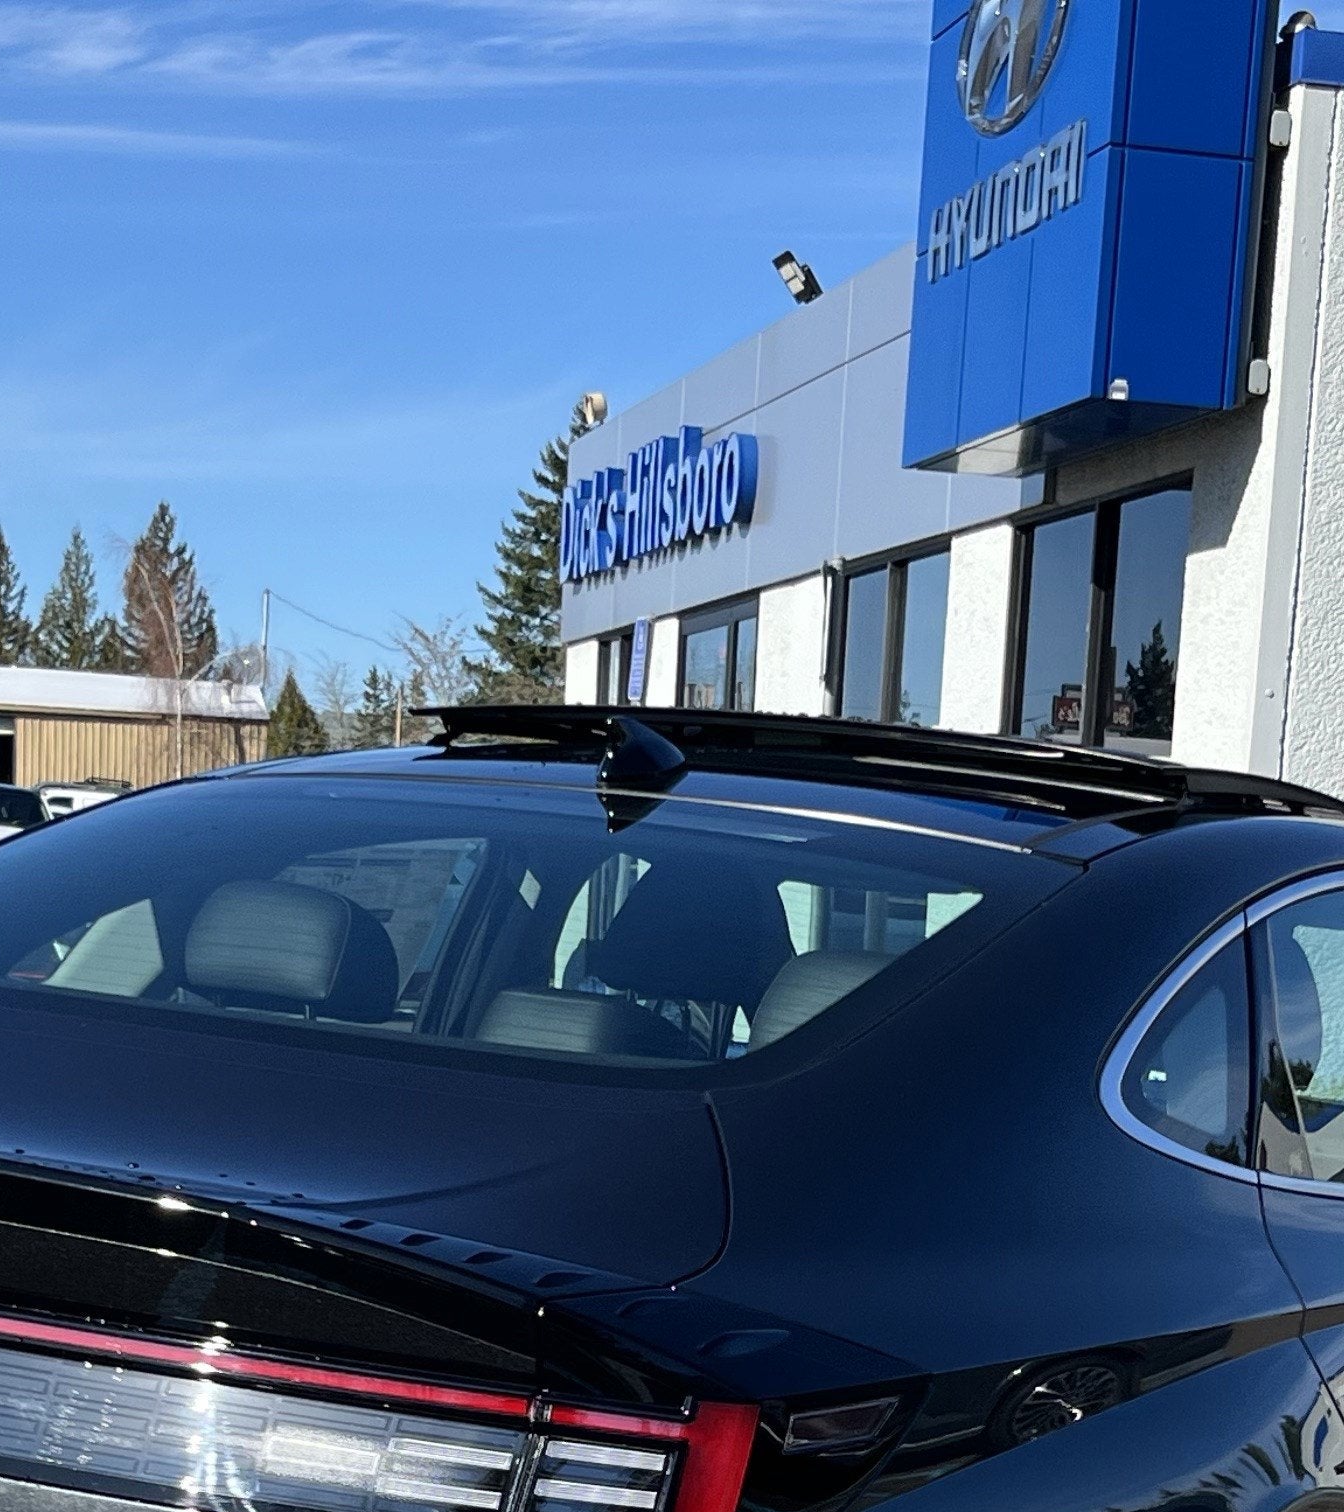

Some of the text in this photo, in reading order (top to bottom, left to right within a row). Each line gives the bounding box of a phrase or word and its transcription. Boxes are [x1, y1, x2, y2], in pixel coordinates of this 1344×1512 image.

[928, 118, 1088, 284] HYUNDAI
[560, 425, 754, 583] Dick's Hillsboro
